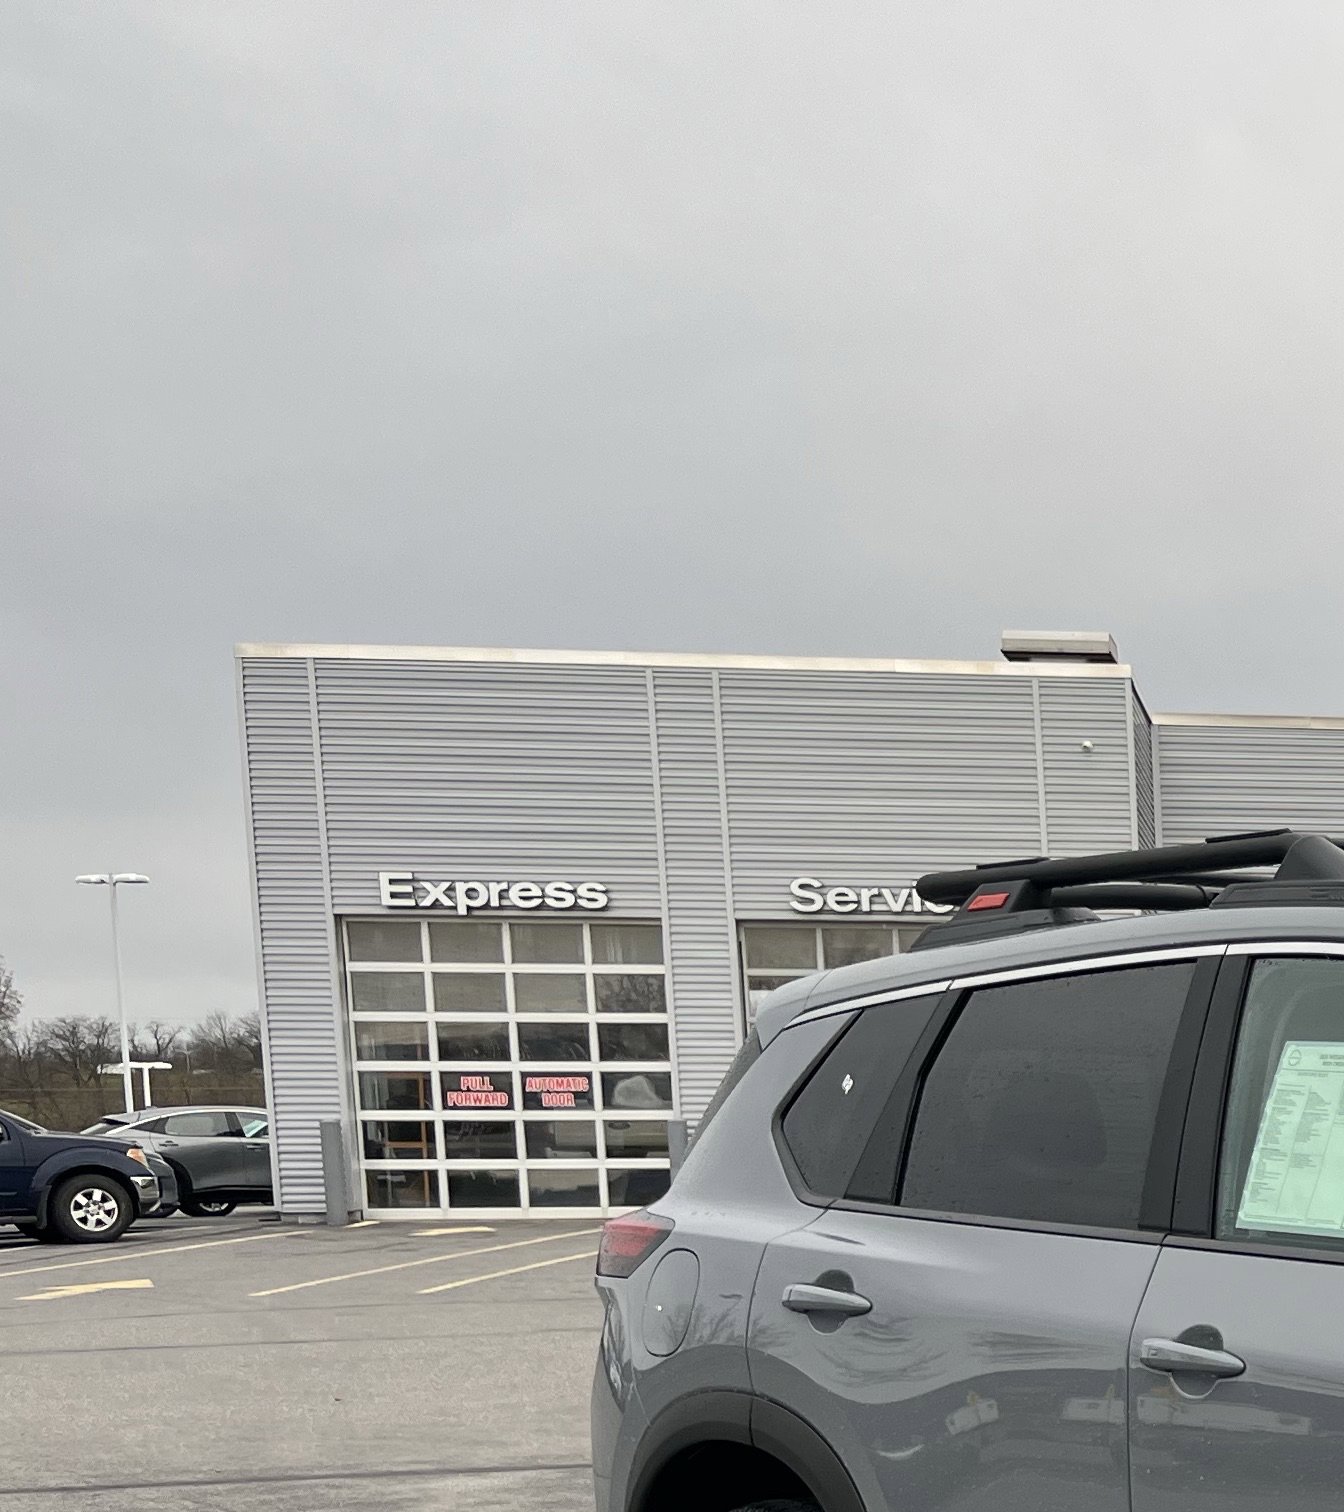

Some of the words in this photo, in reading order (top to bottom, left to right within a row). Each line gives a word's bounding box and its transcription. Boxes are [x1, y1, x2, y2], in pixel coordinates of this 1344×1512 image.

[379, 871, 609, 916] Express
[460, 1076, 494, 1091] PULL
[525, 1076, 590, 1092] AUTOMATIC
[446, 1091, 509, 1107] FORWARD
[541, 1092, 576, 1108] DOOR
